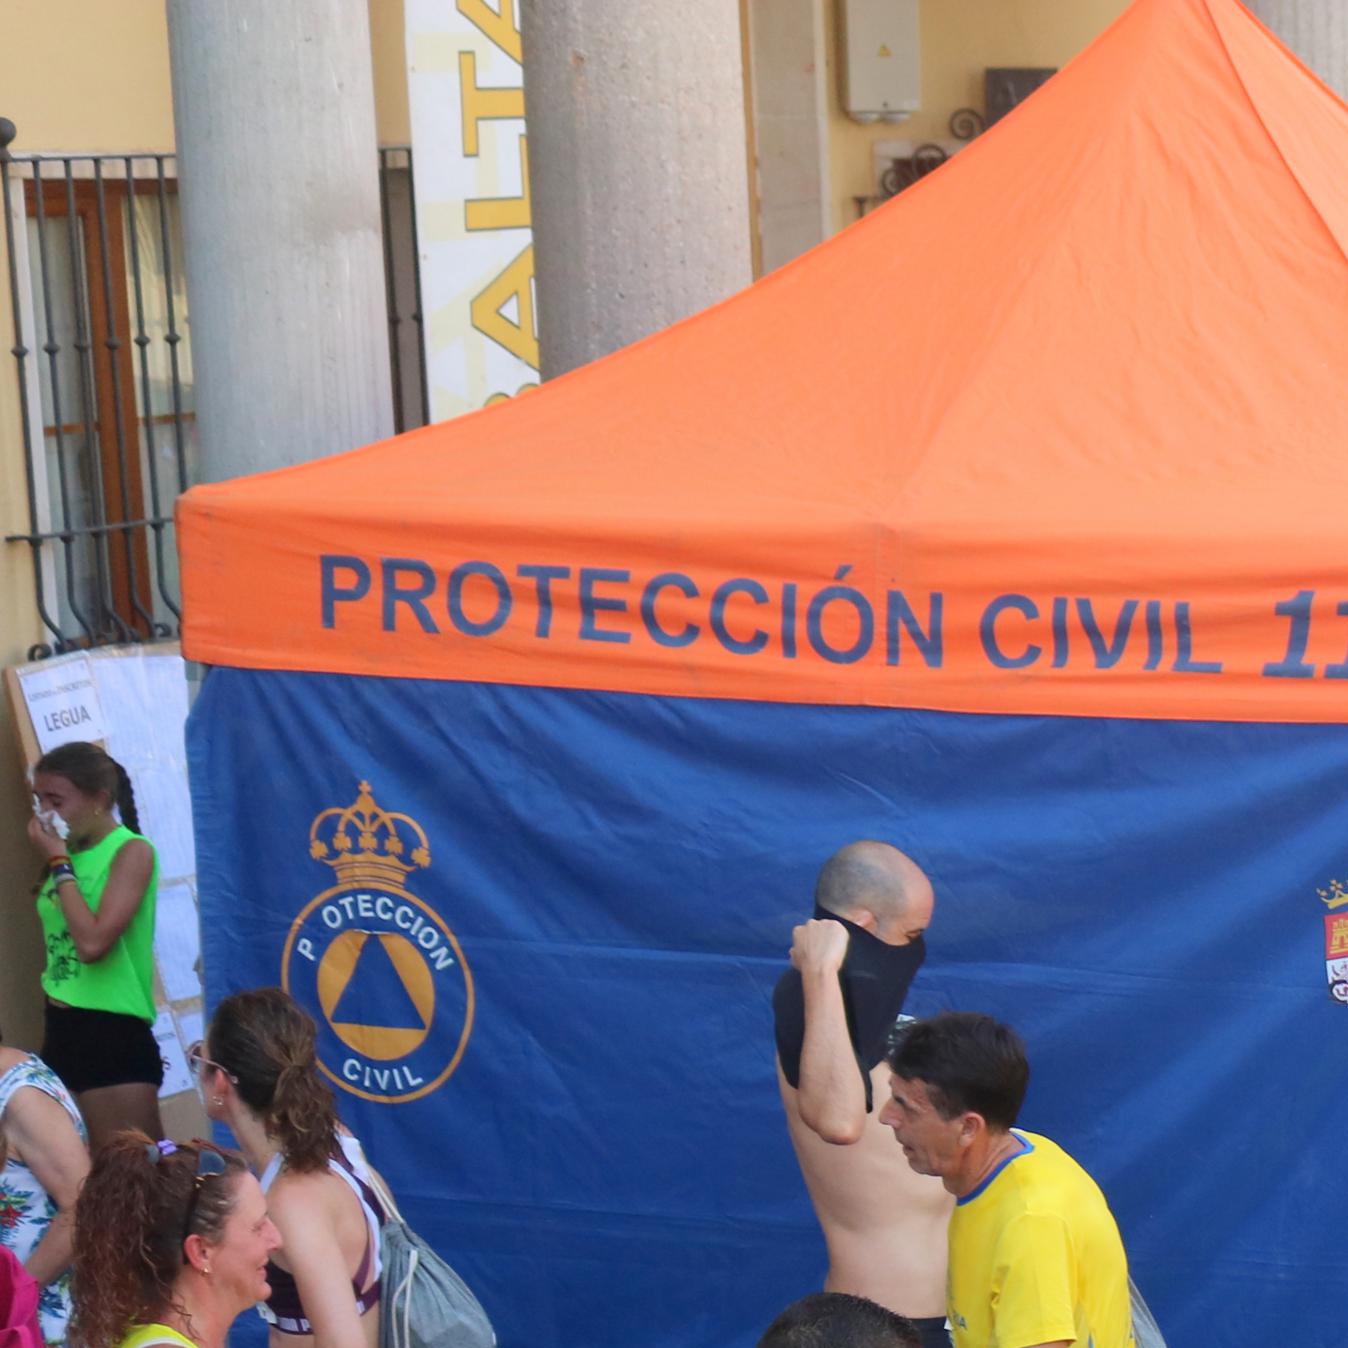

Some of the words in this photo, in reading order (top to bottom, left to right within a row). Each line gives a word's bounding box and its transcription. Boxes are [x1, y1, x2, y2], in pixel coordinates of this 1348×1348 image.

[319, 554, 944, 669] PROTECCIÓN
[978, 593, 1223, 674] CIVIL
[43, 705, 92, 732] LEGUA
[297, 894, 456, 971] POTECCION
[343, 1058, 424, 1090] CIVIL
